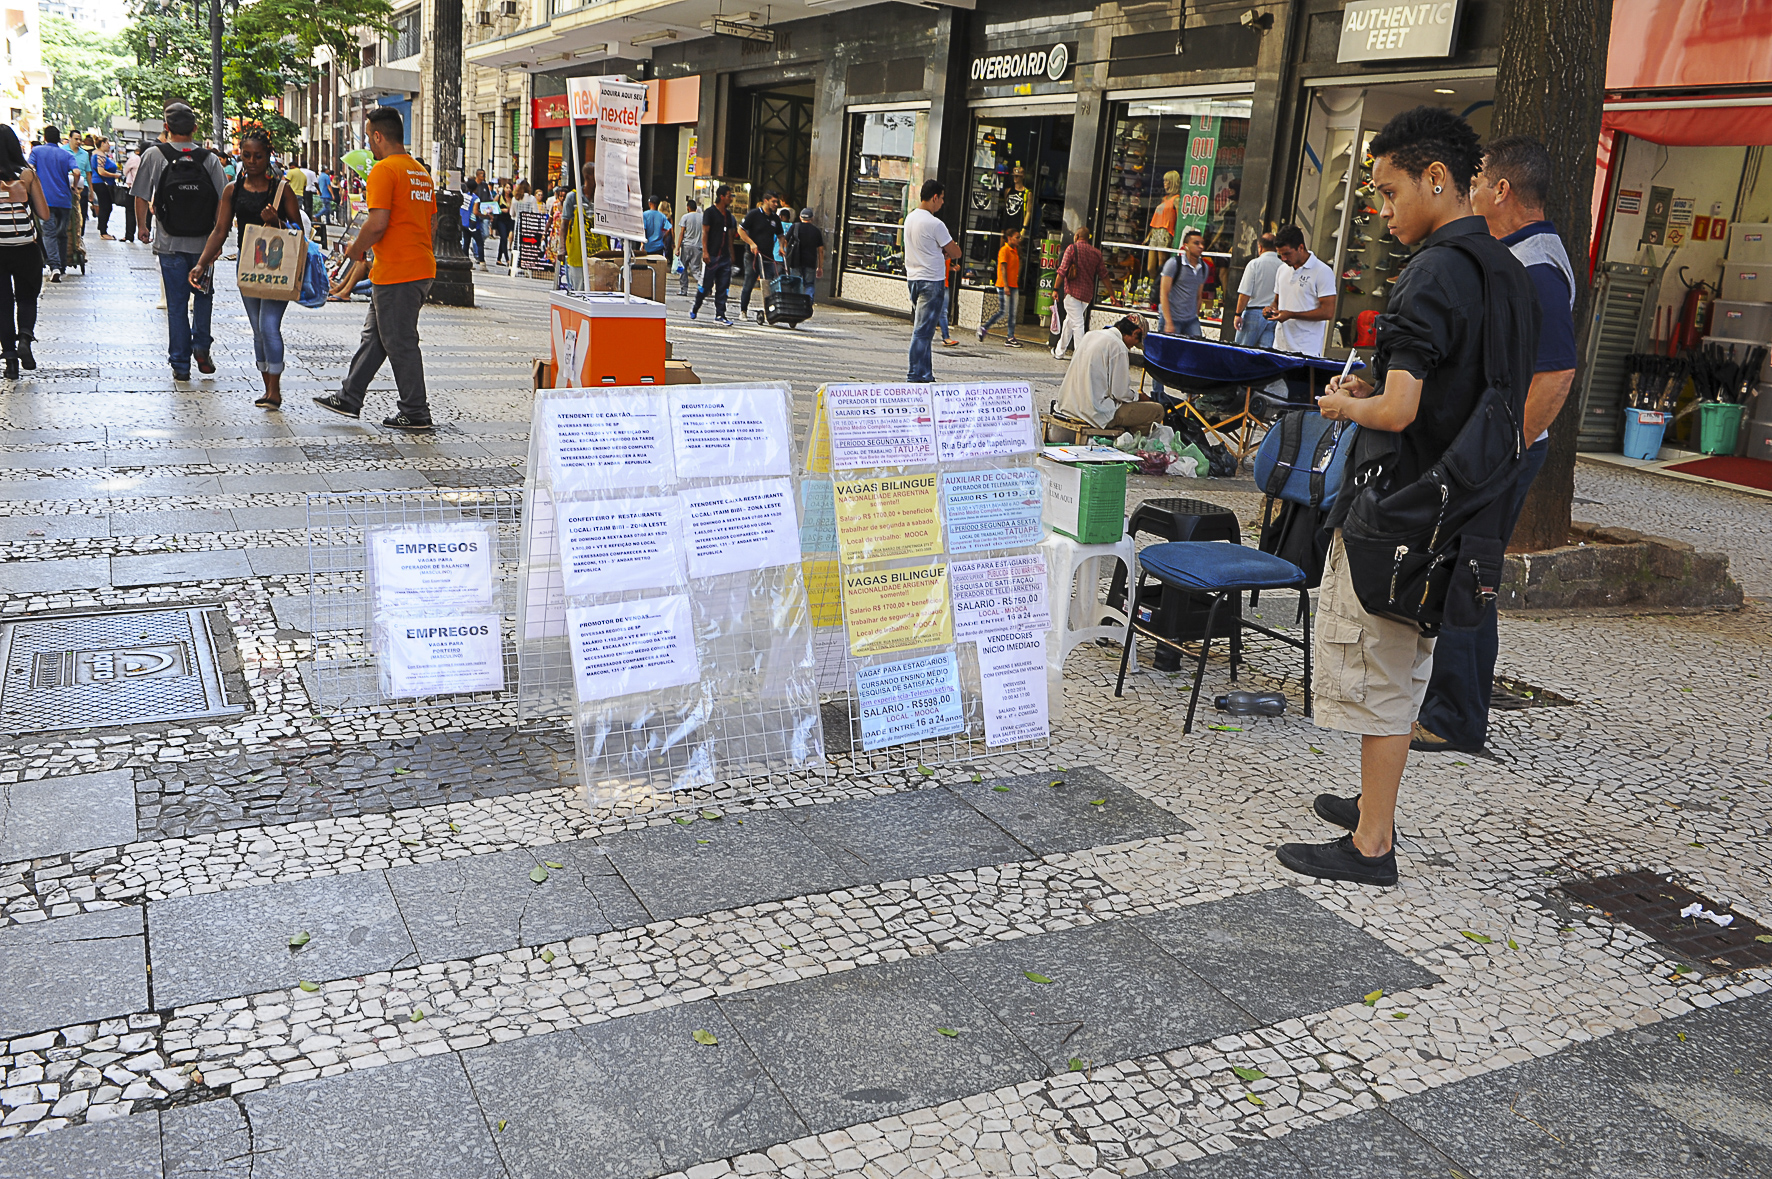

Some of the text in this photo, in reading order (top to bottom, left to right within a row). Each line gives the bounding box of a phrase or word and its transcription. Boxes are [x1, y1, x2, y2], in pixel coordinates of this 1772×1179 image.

[1345, 3, 1451, 32] AUTHENTIC
[1366, 28, 1410, 50] FEET
[971, 52, 1046, 80] OVERBOARD
[601, 89, 643, 101] ADQUIRA AQUI SEU
[573, 89, 599, 115] nex
[601, 106, 638, 127] nextel
[1191, 137, 1214, 160] QUI
[1189, 165, 1208, 186] DA
[1181, 191, 1208, 219] ÇÃO
[596, 212, 609, 224] Tel.
[241, 272, 288, 285] ZAPATA
[1040, 279, 1052, 287] 6X
[830, 389, 868, 397] AUXILIAR
[884, 388, 928, 396] COBRANÇA
[965, 387, 1028, 396] AGENDAMENTO
[837, 478, 935, 495] VAGAS BILINGUE
[945, 476, 981, 485] AUXILIAR
[838, 489, 929, 503] NACIONALIDADE ARGENTINA
[690, 500, 724, 508] ATENDENTE
[841, 525, 868, 533] trabalhar
[879, 522, 905, 530] segunda
[980, 522, 1010, 530] SEGUNDA
[847, 537, 863, 545] Local
[904, 530, 928, 538] MOOCA
[395, 542, 478, 554] EMPREGOS
[953, 564, 975, 572] VAGAS
[847, 575, 888, 587] VAGAS
[891, 568, 945, 583] BILINGUE
[848, 579, 939, 595] NACIONALIDADE ARGENTINA
[850, 607, 871, 615] Salario
[957, 599, 995, 611] SALARIO
[580, 619, 614, 628] PROMOTOR
[851, 617, 878, 626] trabalhar
[406, 625, 489, 639] EMPREGOS
[987, 632, 1033, 643] VENDEDORES
[983, 641, 1040, 655] INÍCIO IMEDIATO
[883, 666, 901, 674] PARA
[861, 668, 948, 690] CURSANDO ENSINO MÉDIO
[903, 677, 944, 689] SATISFAÇÃO
[863, 703, 903, 718] SALARIO
[887, 707, 939, 723] LOCAL MOOCA
[889, 723, 915, 733] ENTRE
[936, 715, 944, 724] 24
